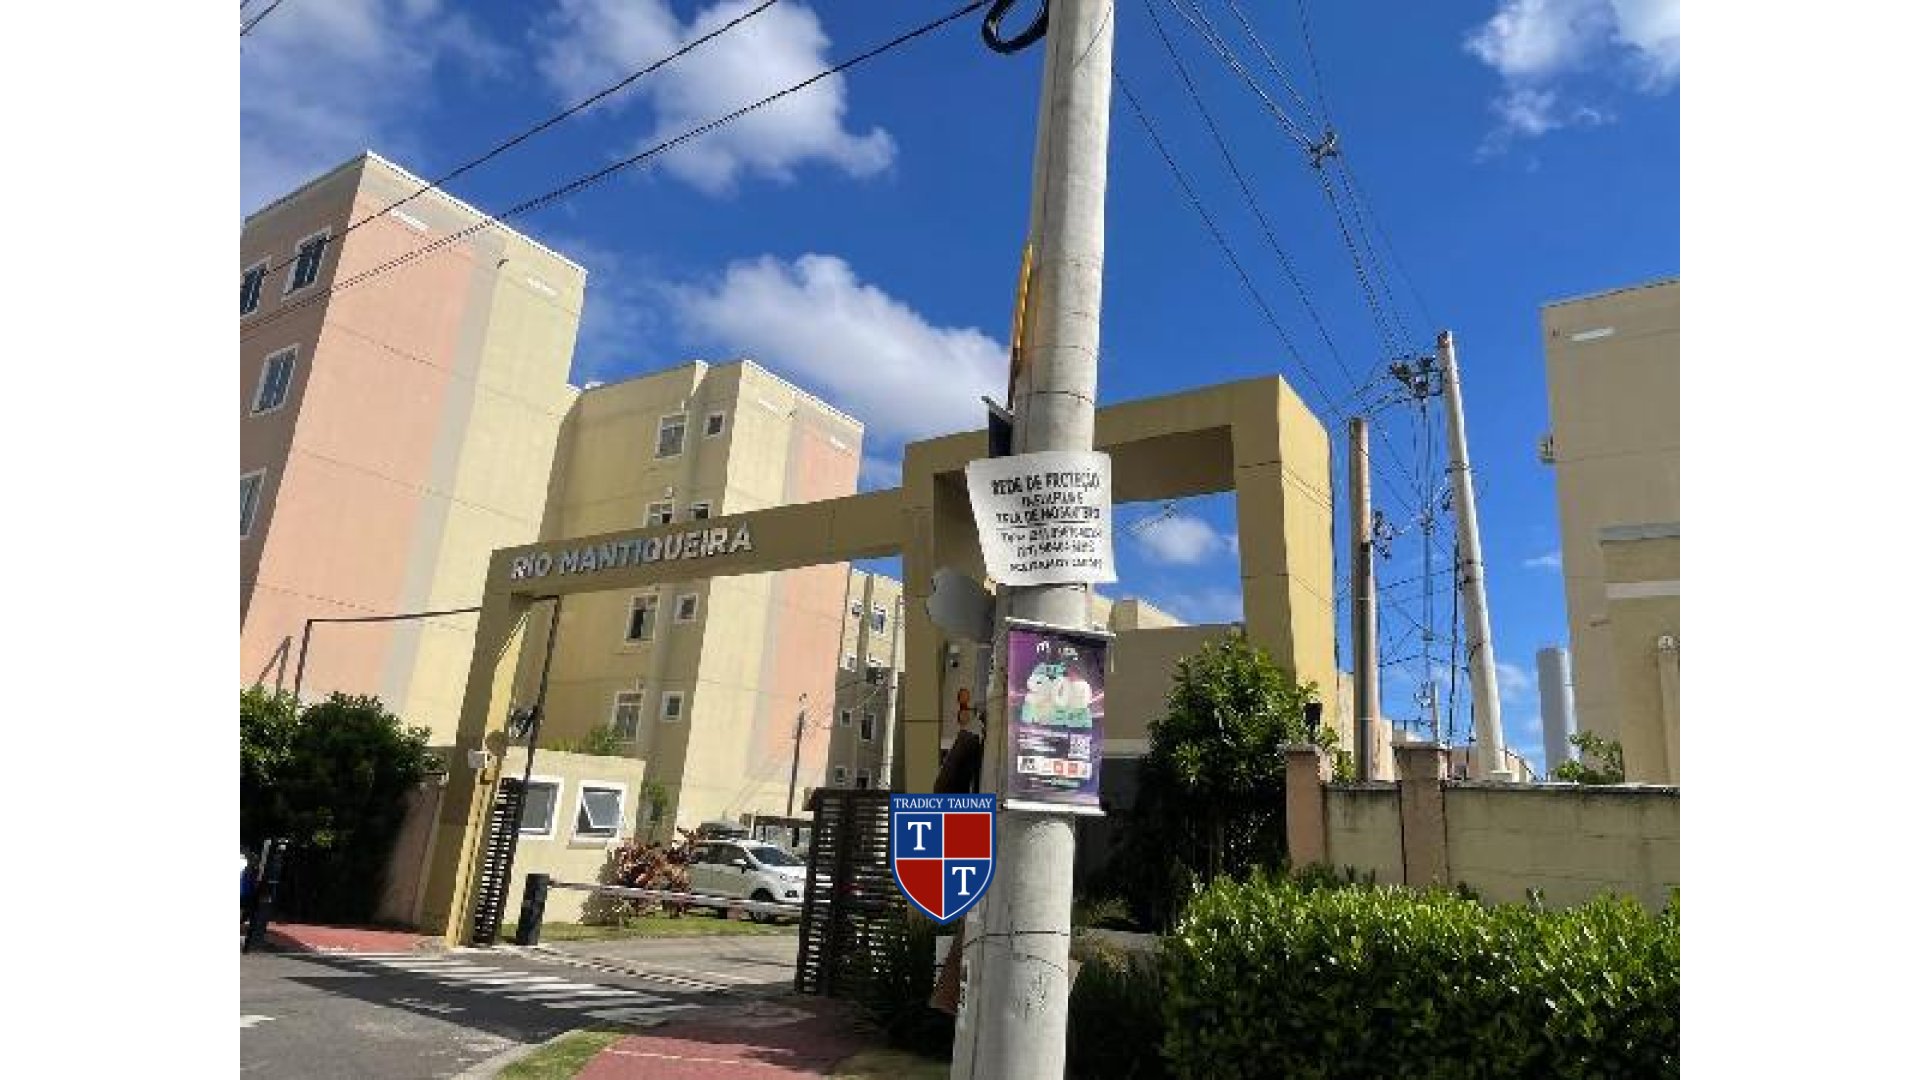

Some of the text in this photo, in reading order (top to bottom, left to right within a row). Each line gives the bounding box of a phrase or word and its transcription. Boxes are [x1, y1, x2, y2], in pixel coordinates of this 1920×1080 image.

[1026, 475, 1042, 492] DE
[511, 523, 753, 580] RIO MANTIQUEIRA
